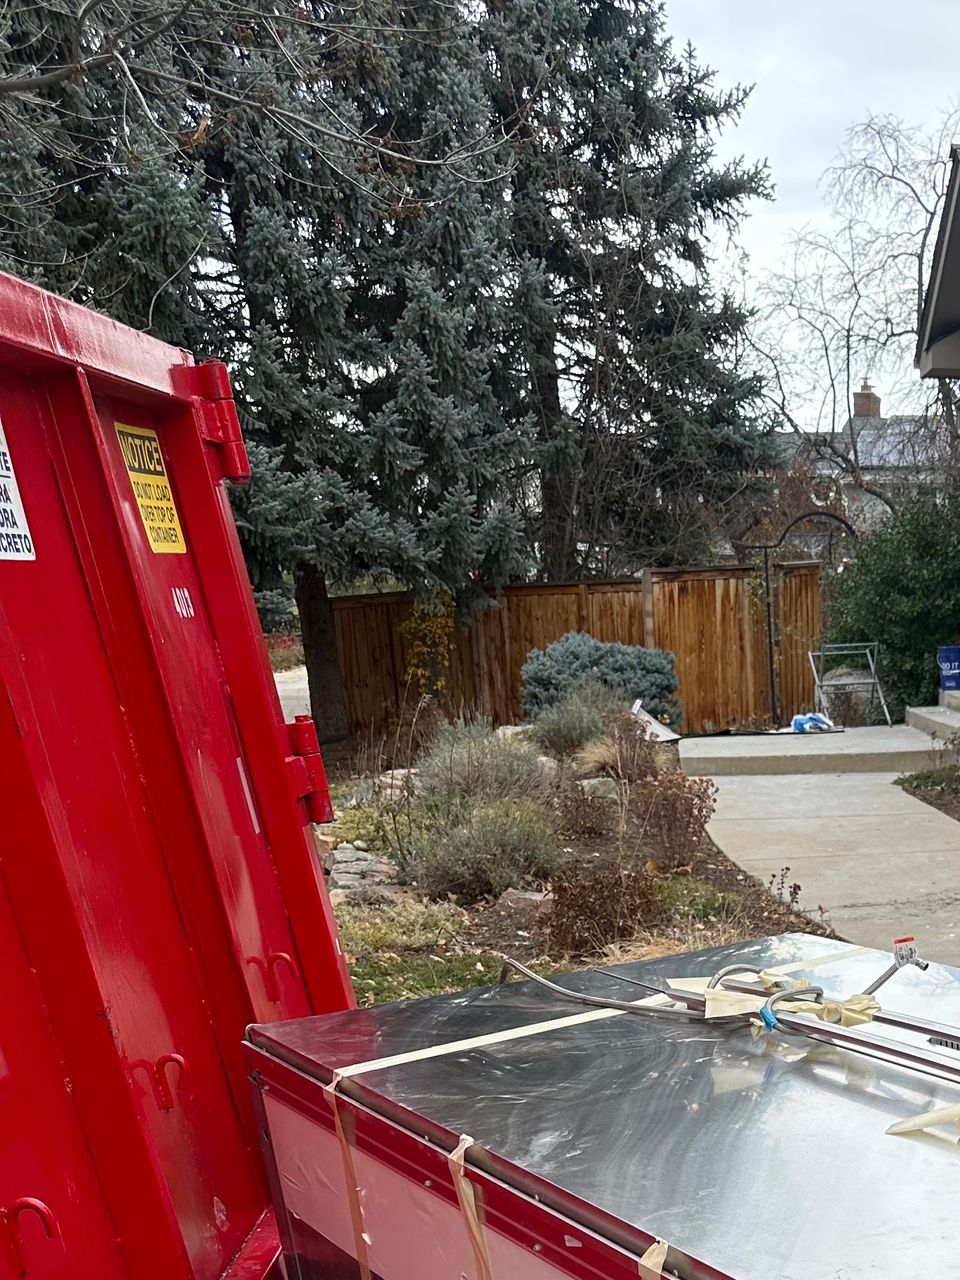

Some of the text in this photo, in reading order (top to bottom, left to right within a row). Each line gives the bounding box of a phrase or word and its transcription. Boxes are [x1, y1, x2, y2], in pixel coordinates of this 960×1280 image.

[120, 434, 162, 471] NOTICE
[133, 481, 171, 502] DO NOT LOAD
[141, 504, 176, 524] OVER TOP OF
[148, 525, 180, 544] CONTAINER
[171, 587, 195, 618] 4013
